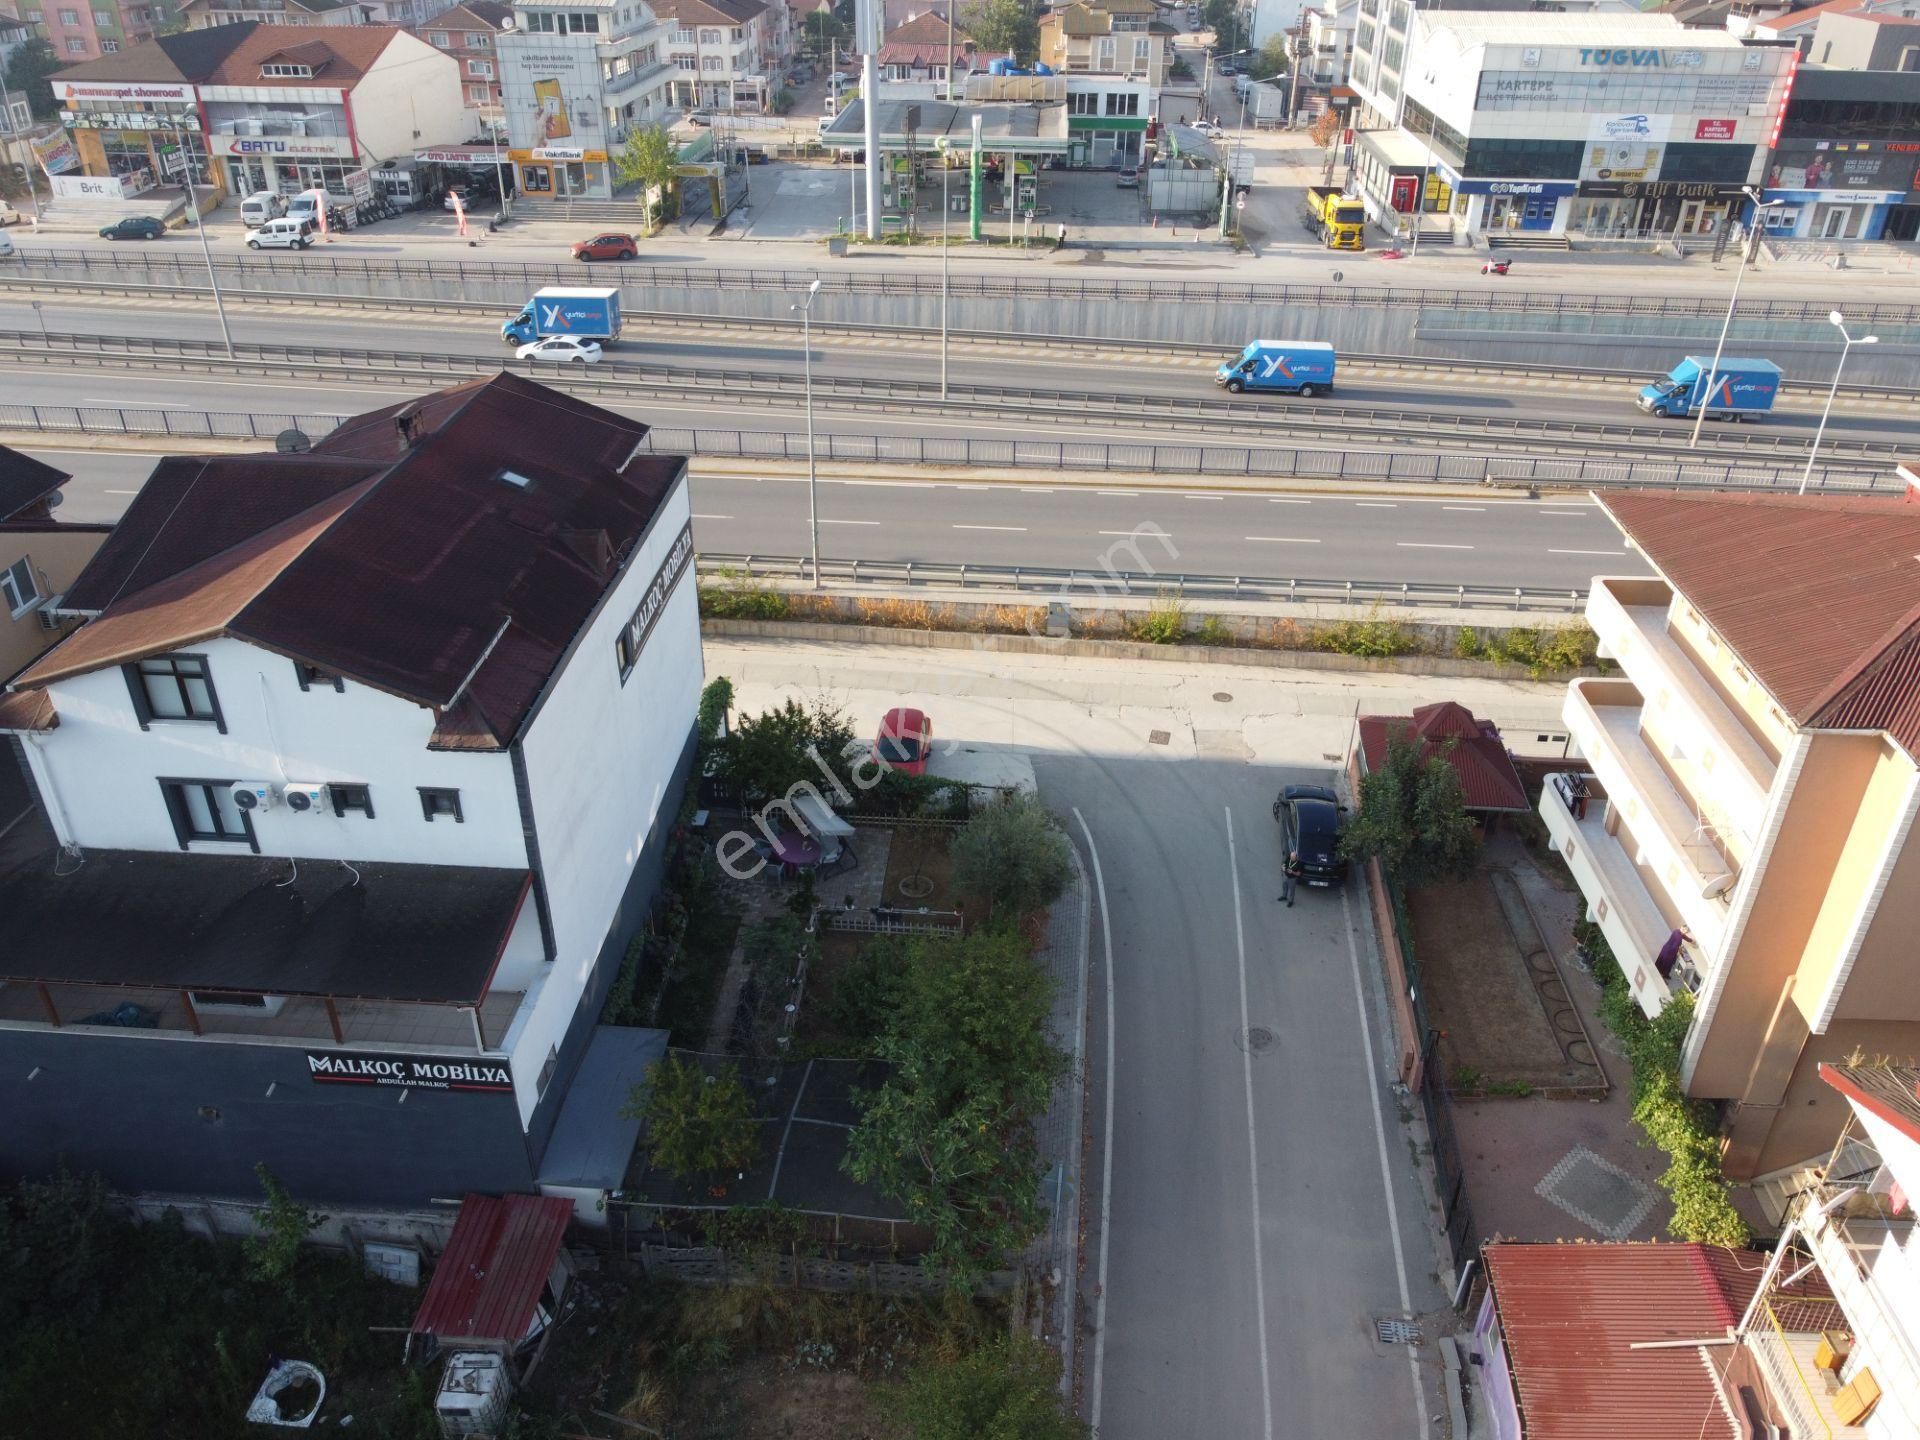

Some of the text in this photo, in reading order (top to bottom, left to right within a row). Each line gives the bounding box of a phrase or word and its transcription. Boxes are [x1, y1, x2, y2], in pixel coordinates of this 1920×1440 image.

[1496, 80, 1554, 91] KARTEPE
[134, 87, 183, 98] showroom
[241, 140, 285, 152] BATU
[80, 182, 103, 194] Brit
[631, 579, 663, 649] MALKOÇ
[662, 528, 692, 590] MOBİLYA
[307, 1055, 511, 1083] MALKOÇ MOBİLYA
[376, 1077, 450, 1089] ABDULLAH MALKOÇ
